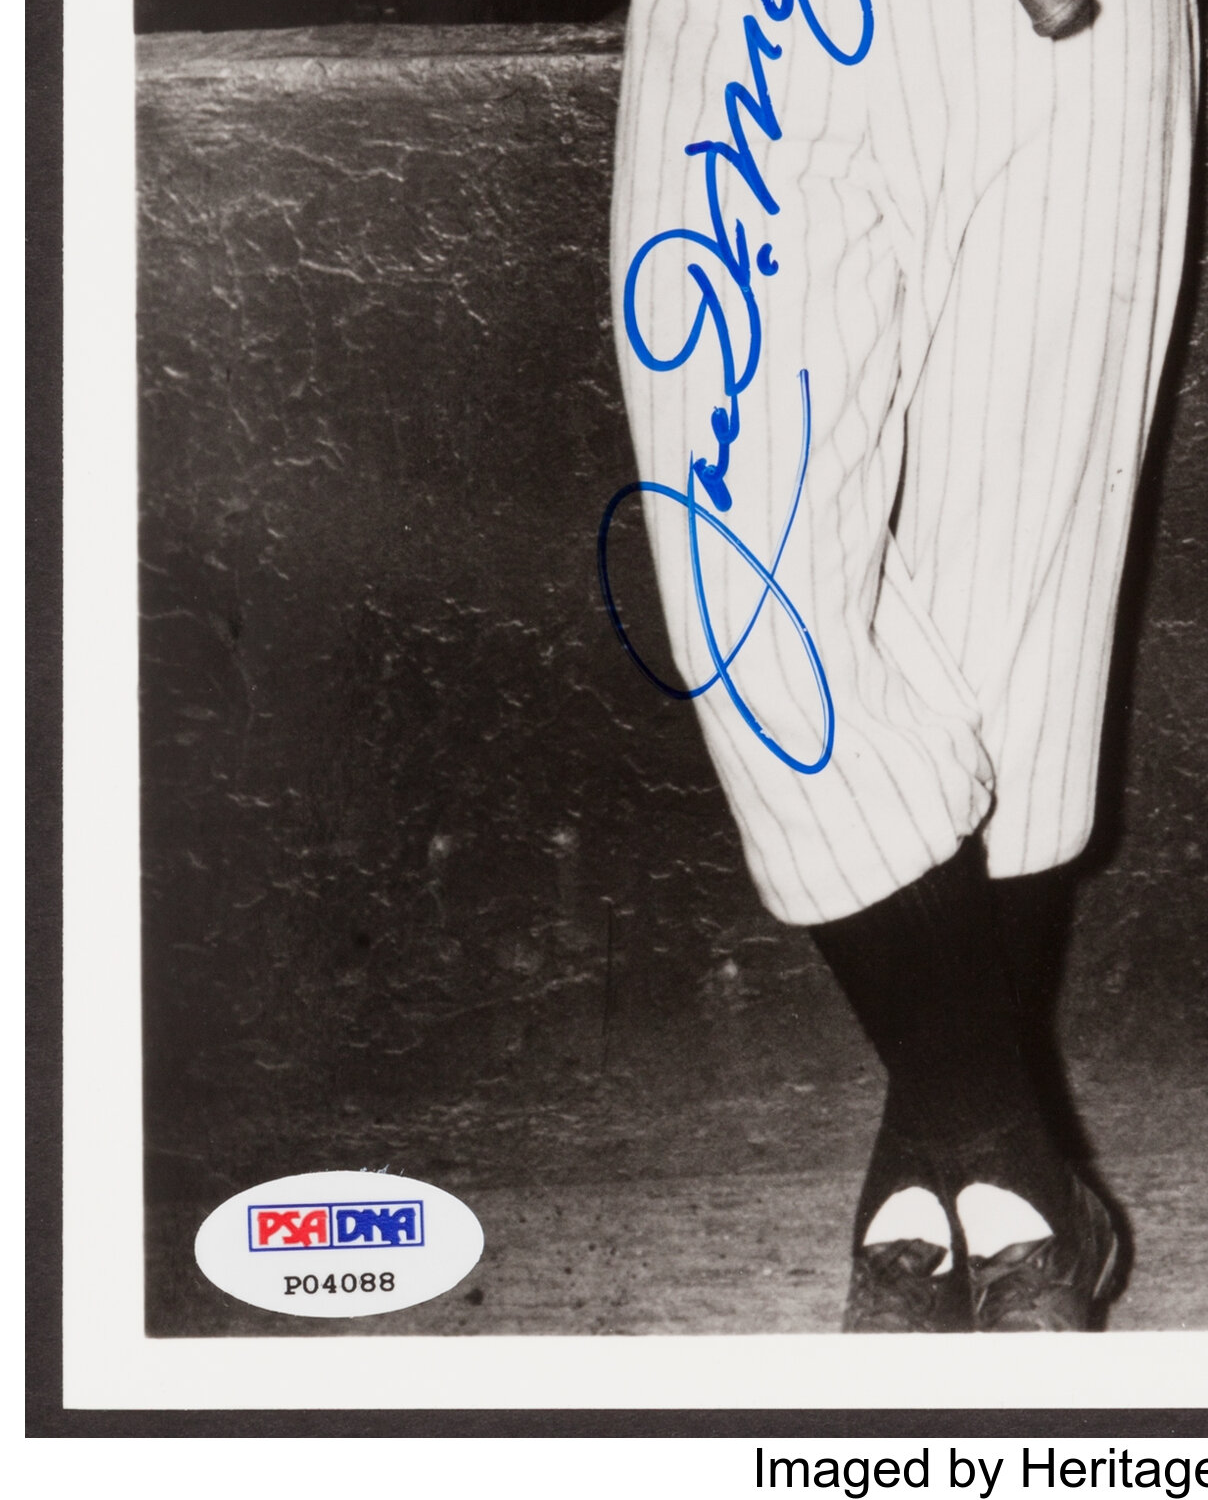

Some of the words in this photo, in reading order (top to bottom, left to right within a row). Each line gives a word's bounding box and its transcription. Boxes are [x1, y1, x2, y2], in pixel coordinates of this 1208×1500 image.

[599, 368, 835, 775] Joe
[256, 1209, 328, 1247] PSA
[336, 1207, 416, 1245] DNA
